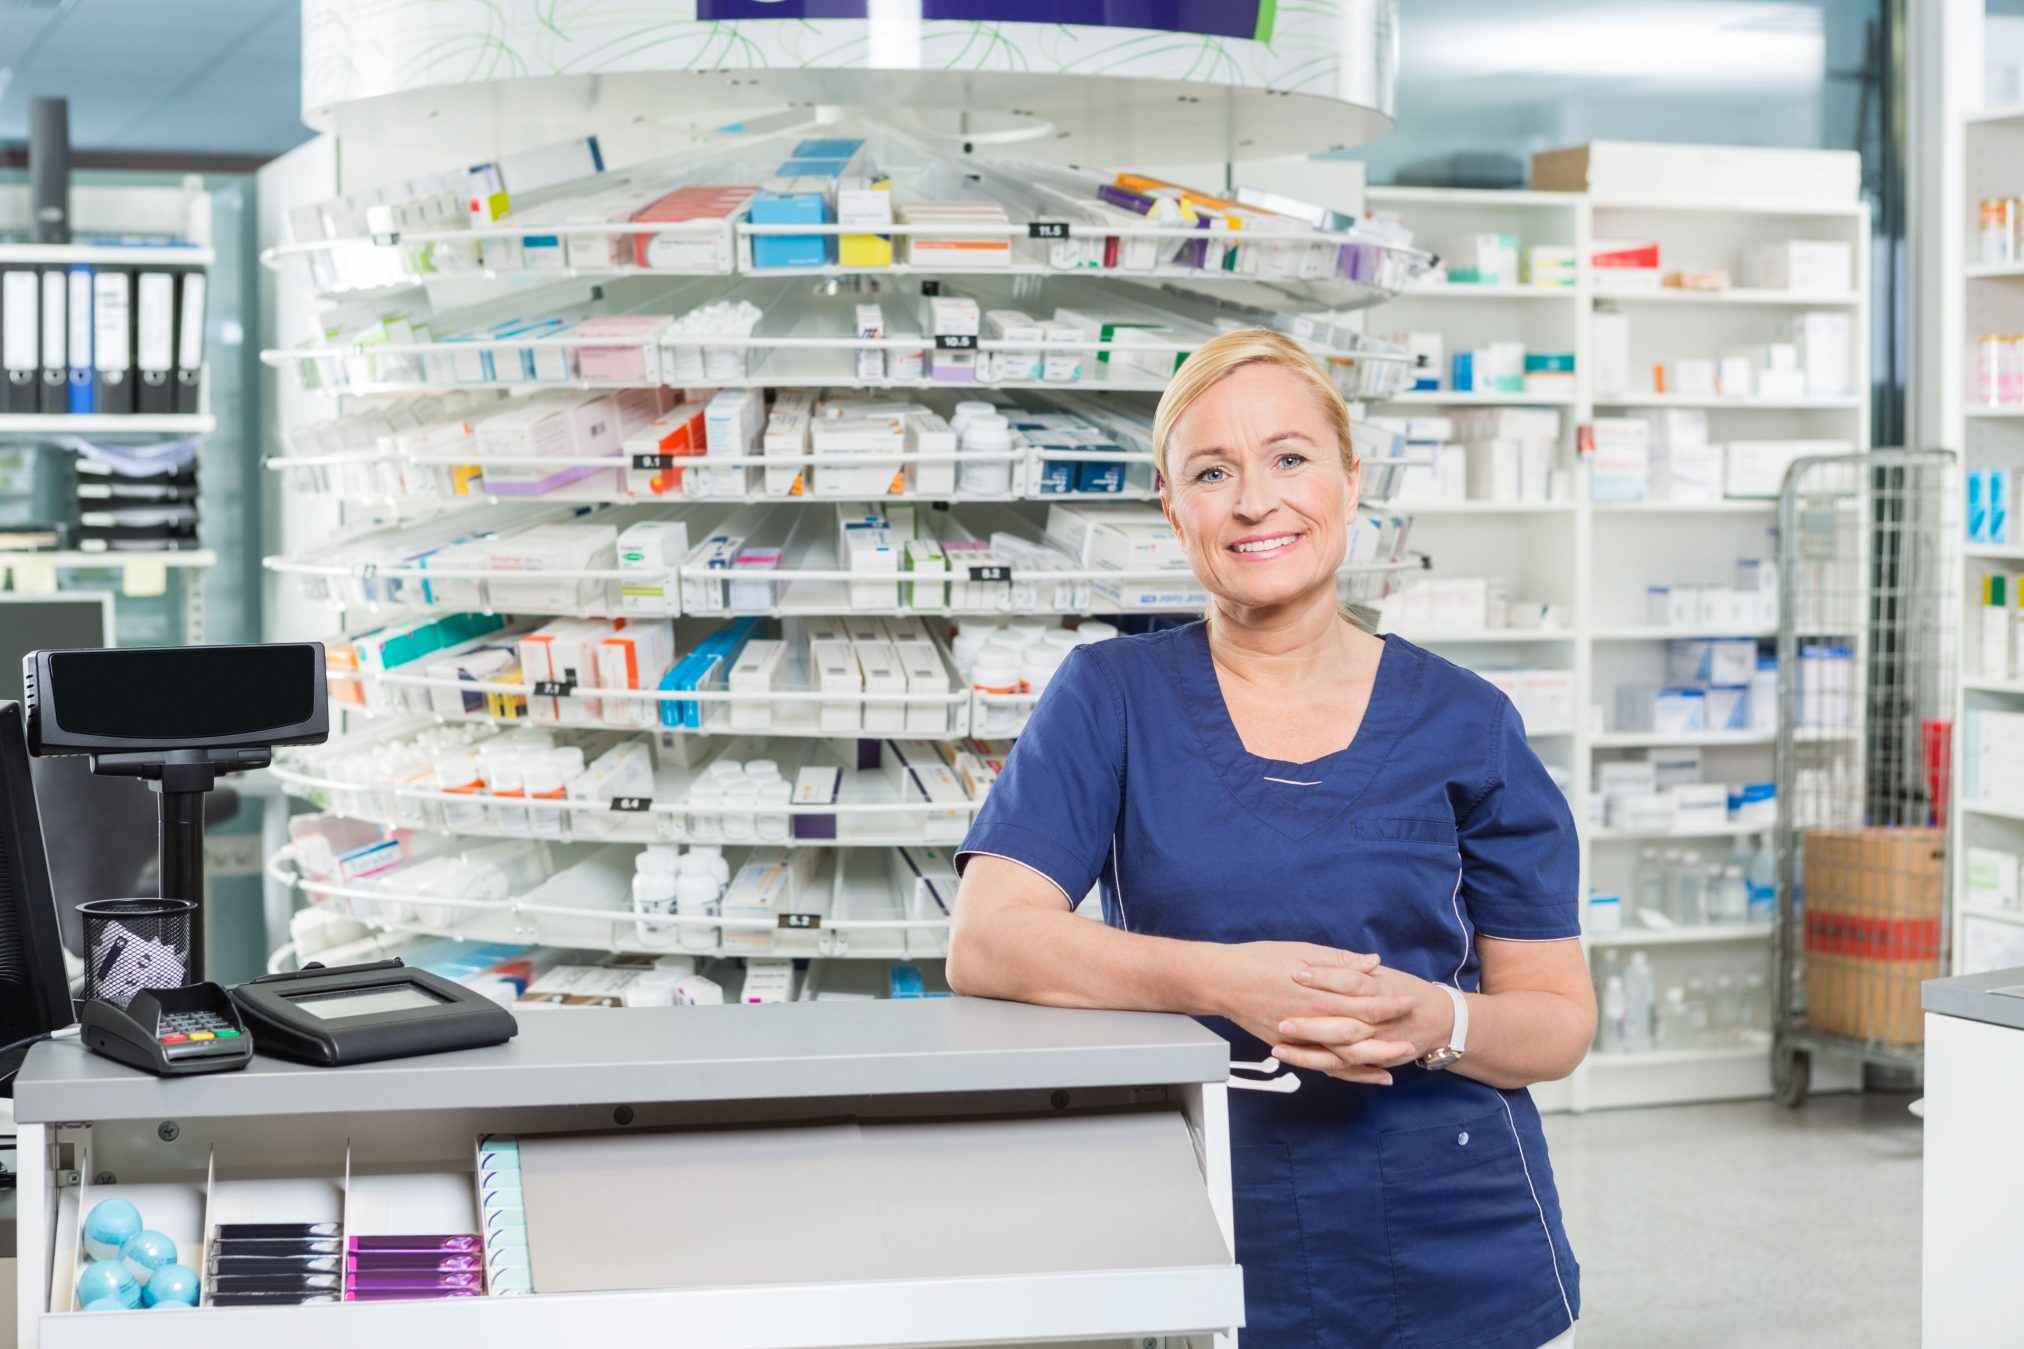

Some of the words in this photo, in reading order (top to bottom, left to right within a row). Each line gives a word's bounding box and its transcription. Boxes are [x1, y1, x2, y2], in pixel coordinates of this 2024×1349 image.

[1039, 225, 1061, 236] 11.5
[944, 337, 970, 347] 10.5
[643, 456, 660, 467] 9.1
[545, 683, 561, 694] 7.1
